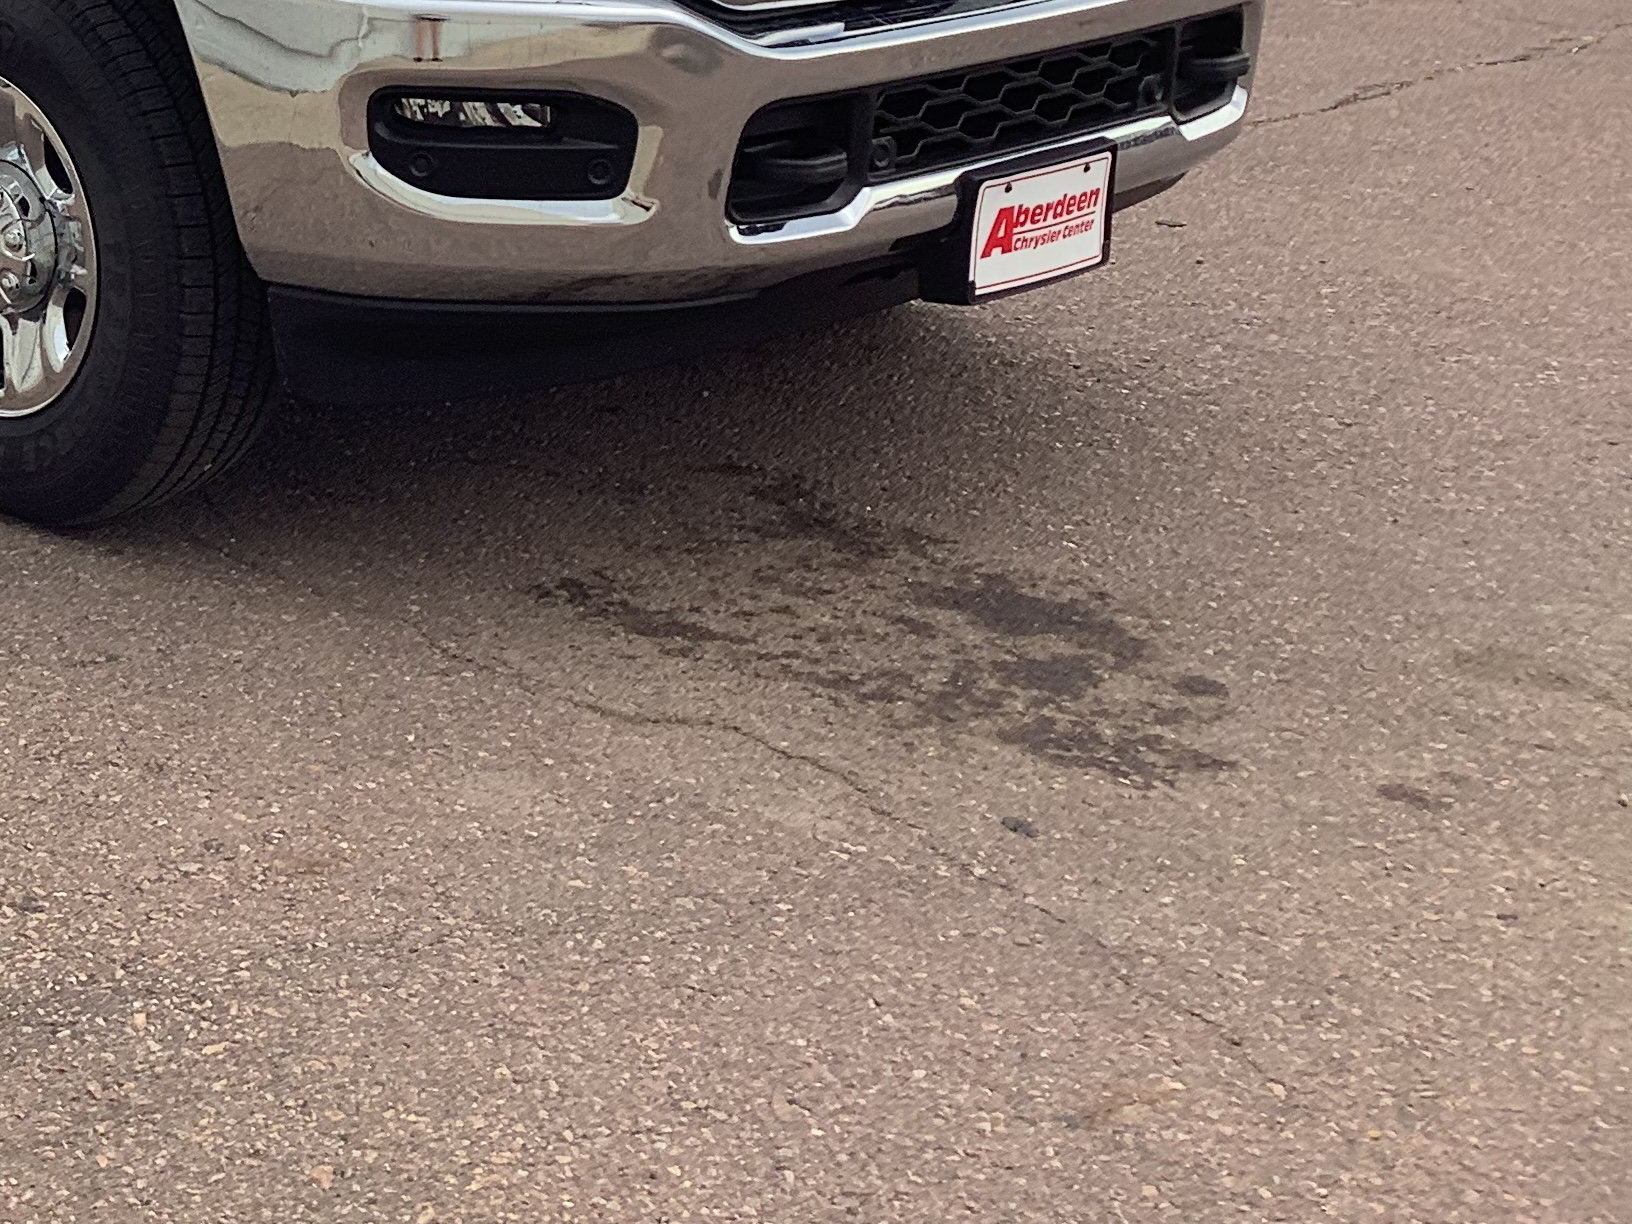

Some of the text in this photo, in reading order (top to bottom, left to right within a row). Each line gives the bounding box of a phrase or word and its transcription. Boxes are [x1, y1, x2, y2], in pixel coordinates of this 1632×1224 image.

[980, 187, 1101, 260] Aberdeen
[1013, 219, 1095, 251] Chrysler Center
